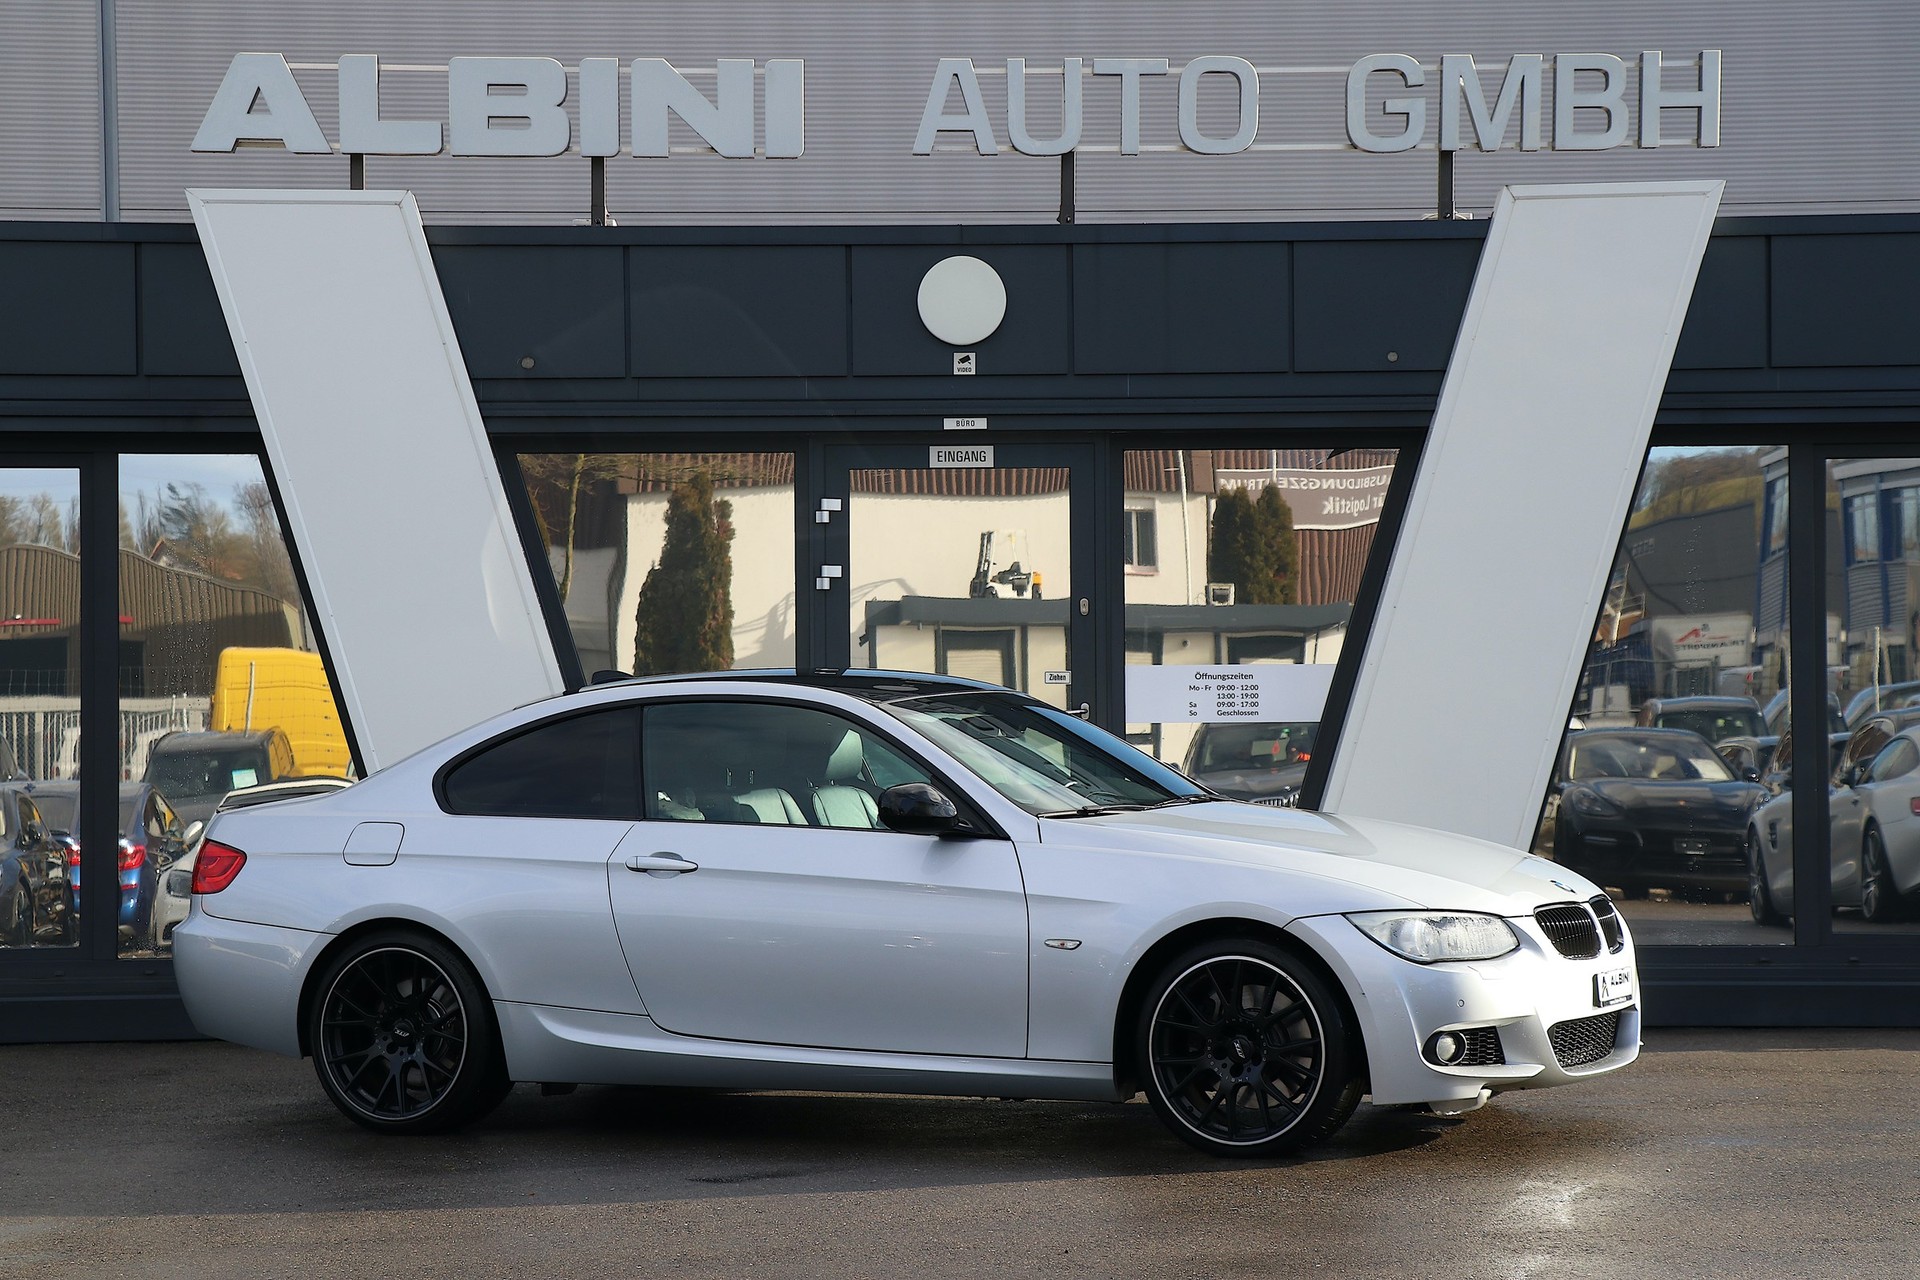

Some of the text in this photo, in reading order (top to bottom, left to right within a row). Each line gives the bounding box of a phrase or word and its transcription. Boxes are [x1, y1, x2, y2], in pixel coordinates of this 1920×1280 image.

[190, 48, 1724, 159] ALBINI AUTO GMBH
[956, 419, 975, 427] BÜRO
[937, 450, 987, 463] EINGANG
[1195, 671, 1254, 681] Öffnungszeiten
